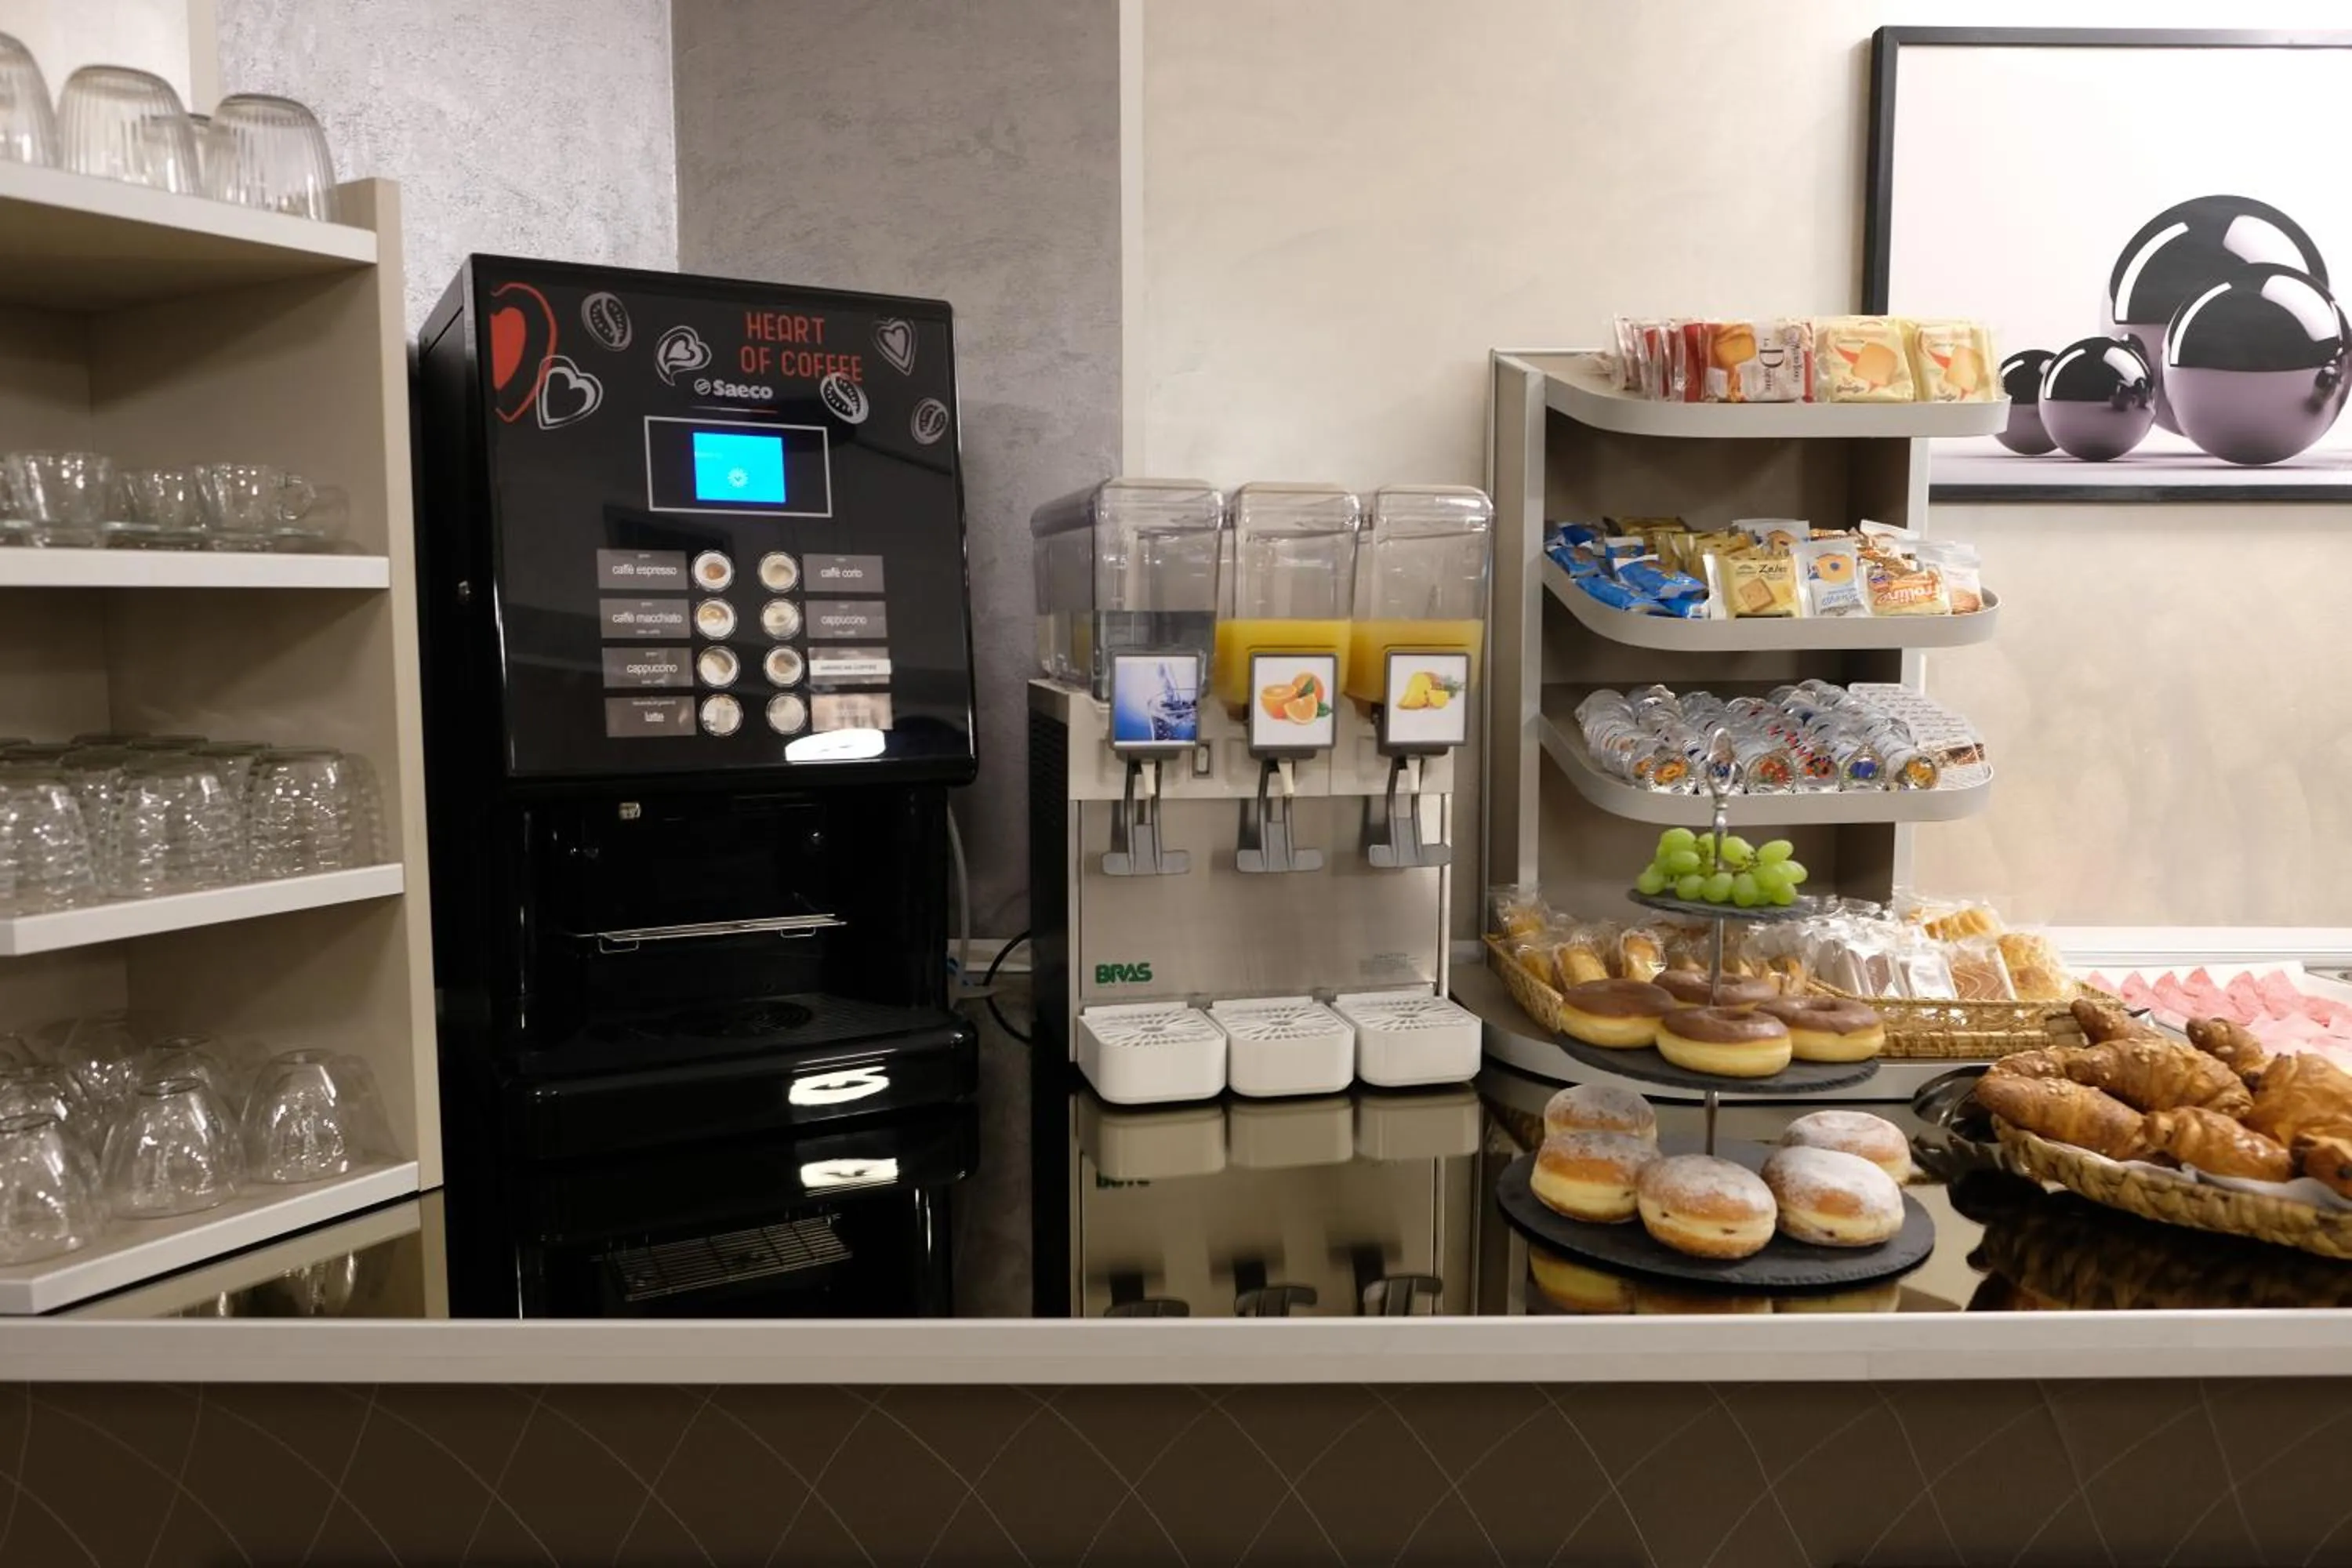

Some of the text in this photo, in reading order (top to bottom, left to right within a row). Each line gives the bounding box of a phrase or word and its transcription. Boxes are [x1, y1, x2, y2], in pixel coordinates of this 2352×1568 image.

[746, 312, 825, 345] HEART
[740, 346, 862, 382] OF COFFEE
[713, 379, 774, 399] Saeco
[636, 566, 677, 578] espresso
[626, 664, 678, 676] cappuccino
[1095, 962, 1152, 984] BRAS
